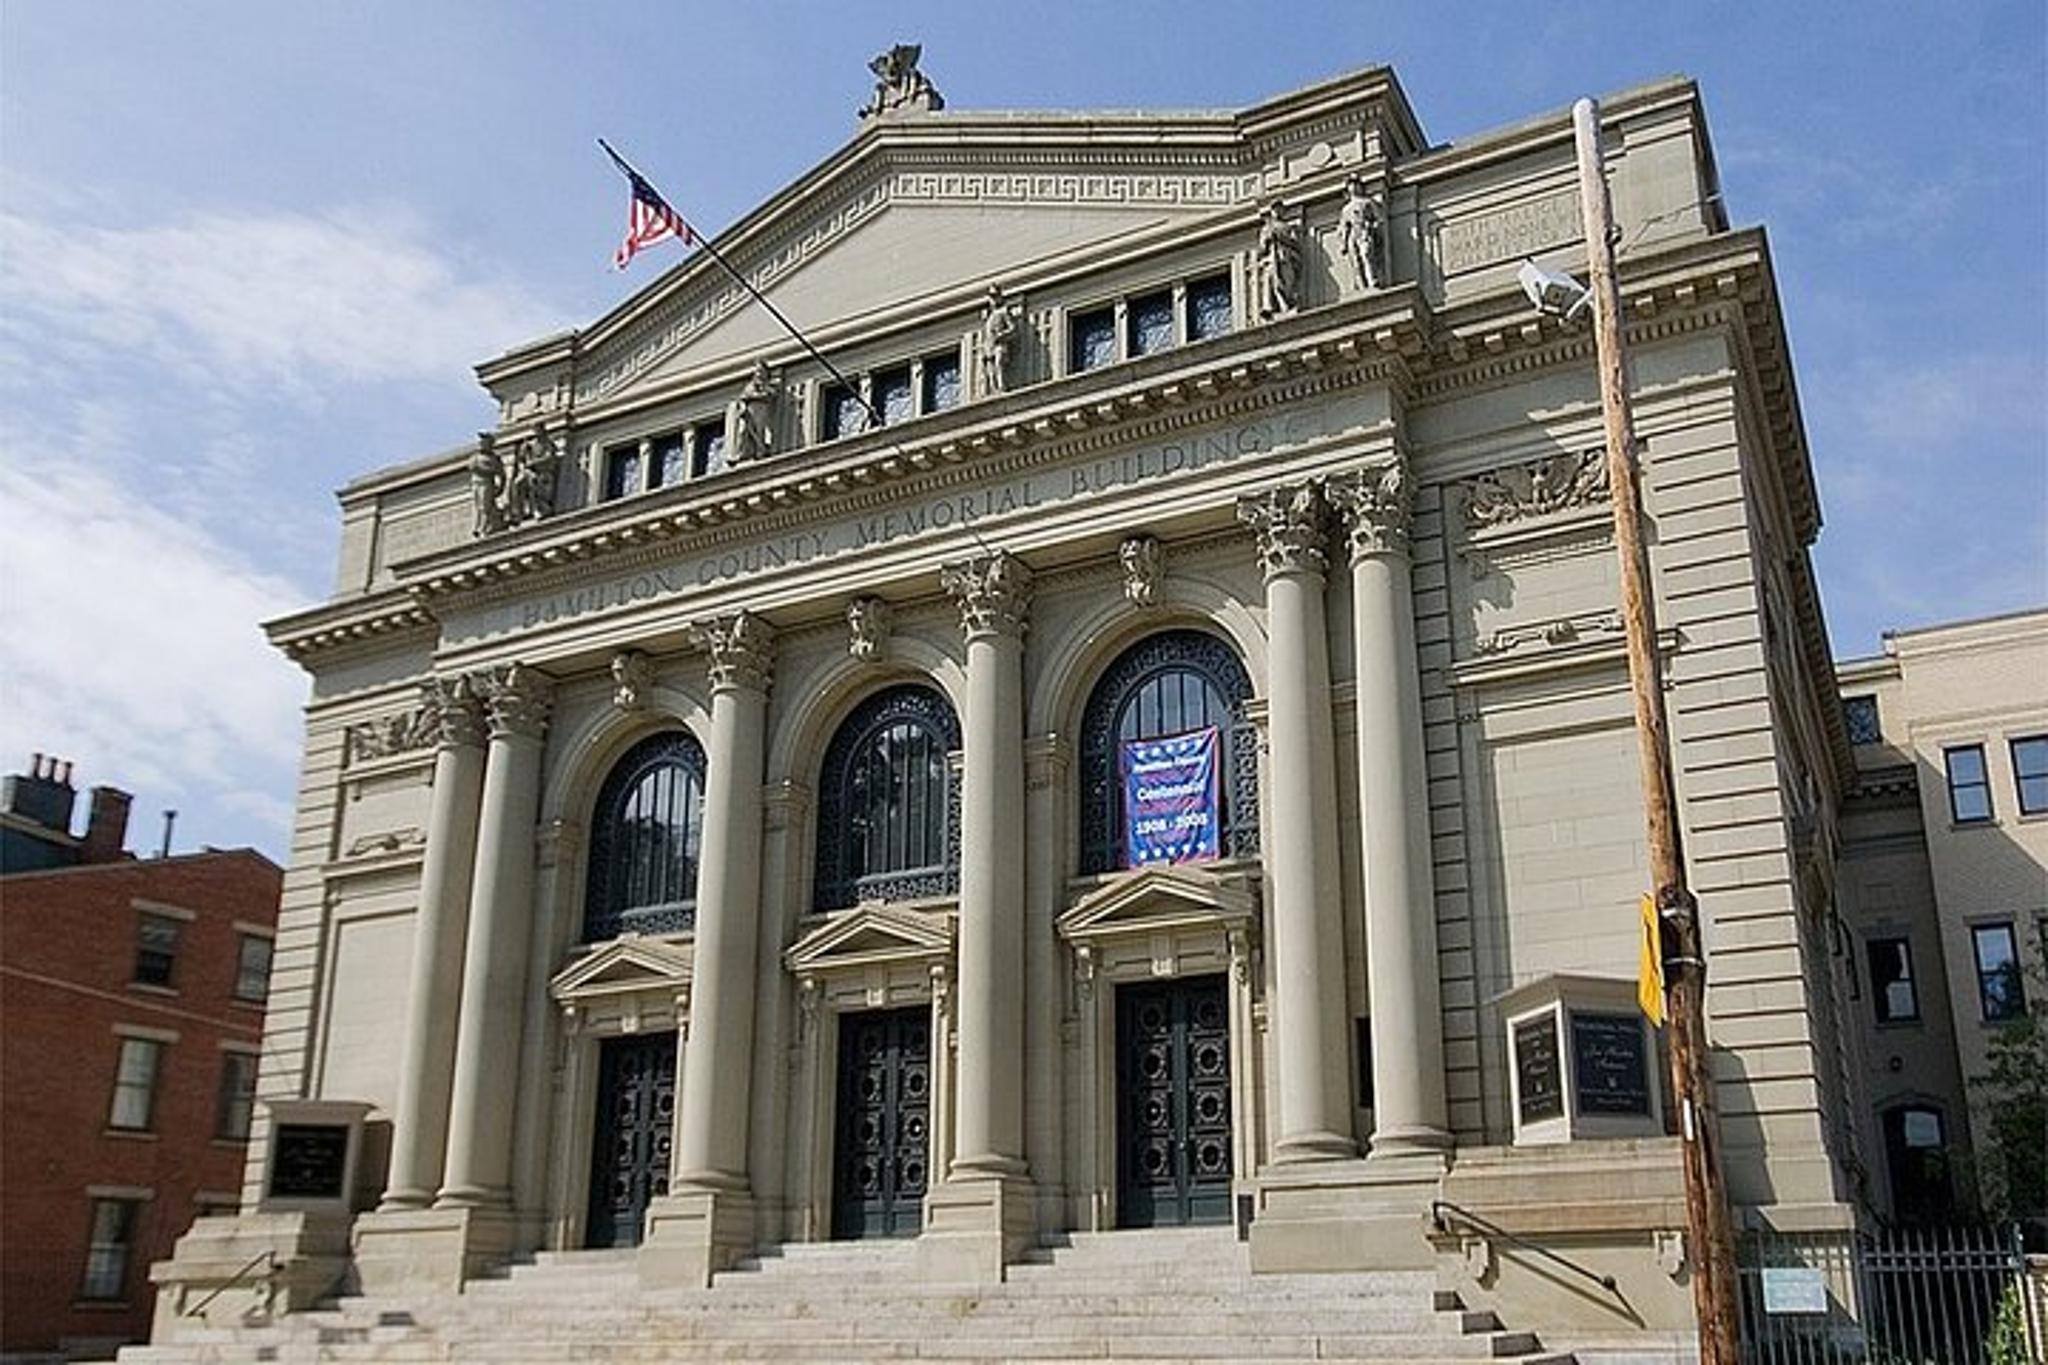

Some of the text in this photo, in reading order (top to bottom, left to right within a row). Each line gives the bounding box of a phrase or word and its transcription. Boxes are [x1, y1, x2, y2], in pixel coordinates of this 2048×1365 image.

[523, 426, 1260, 629] HAMILTON COUNTY MEMORIAL BUILDING
